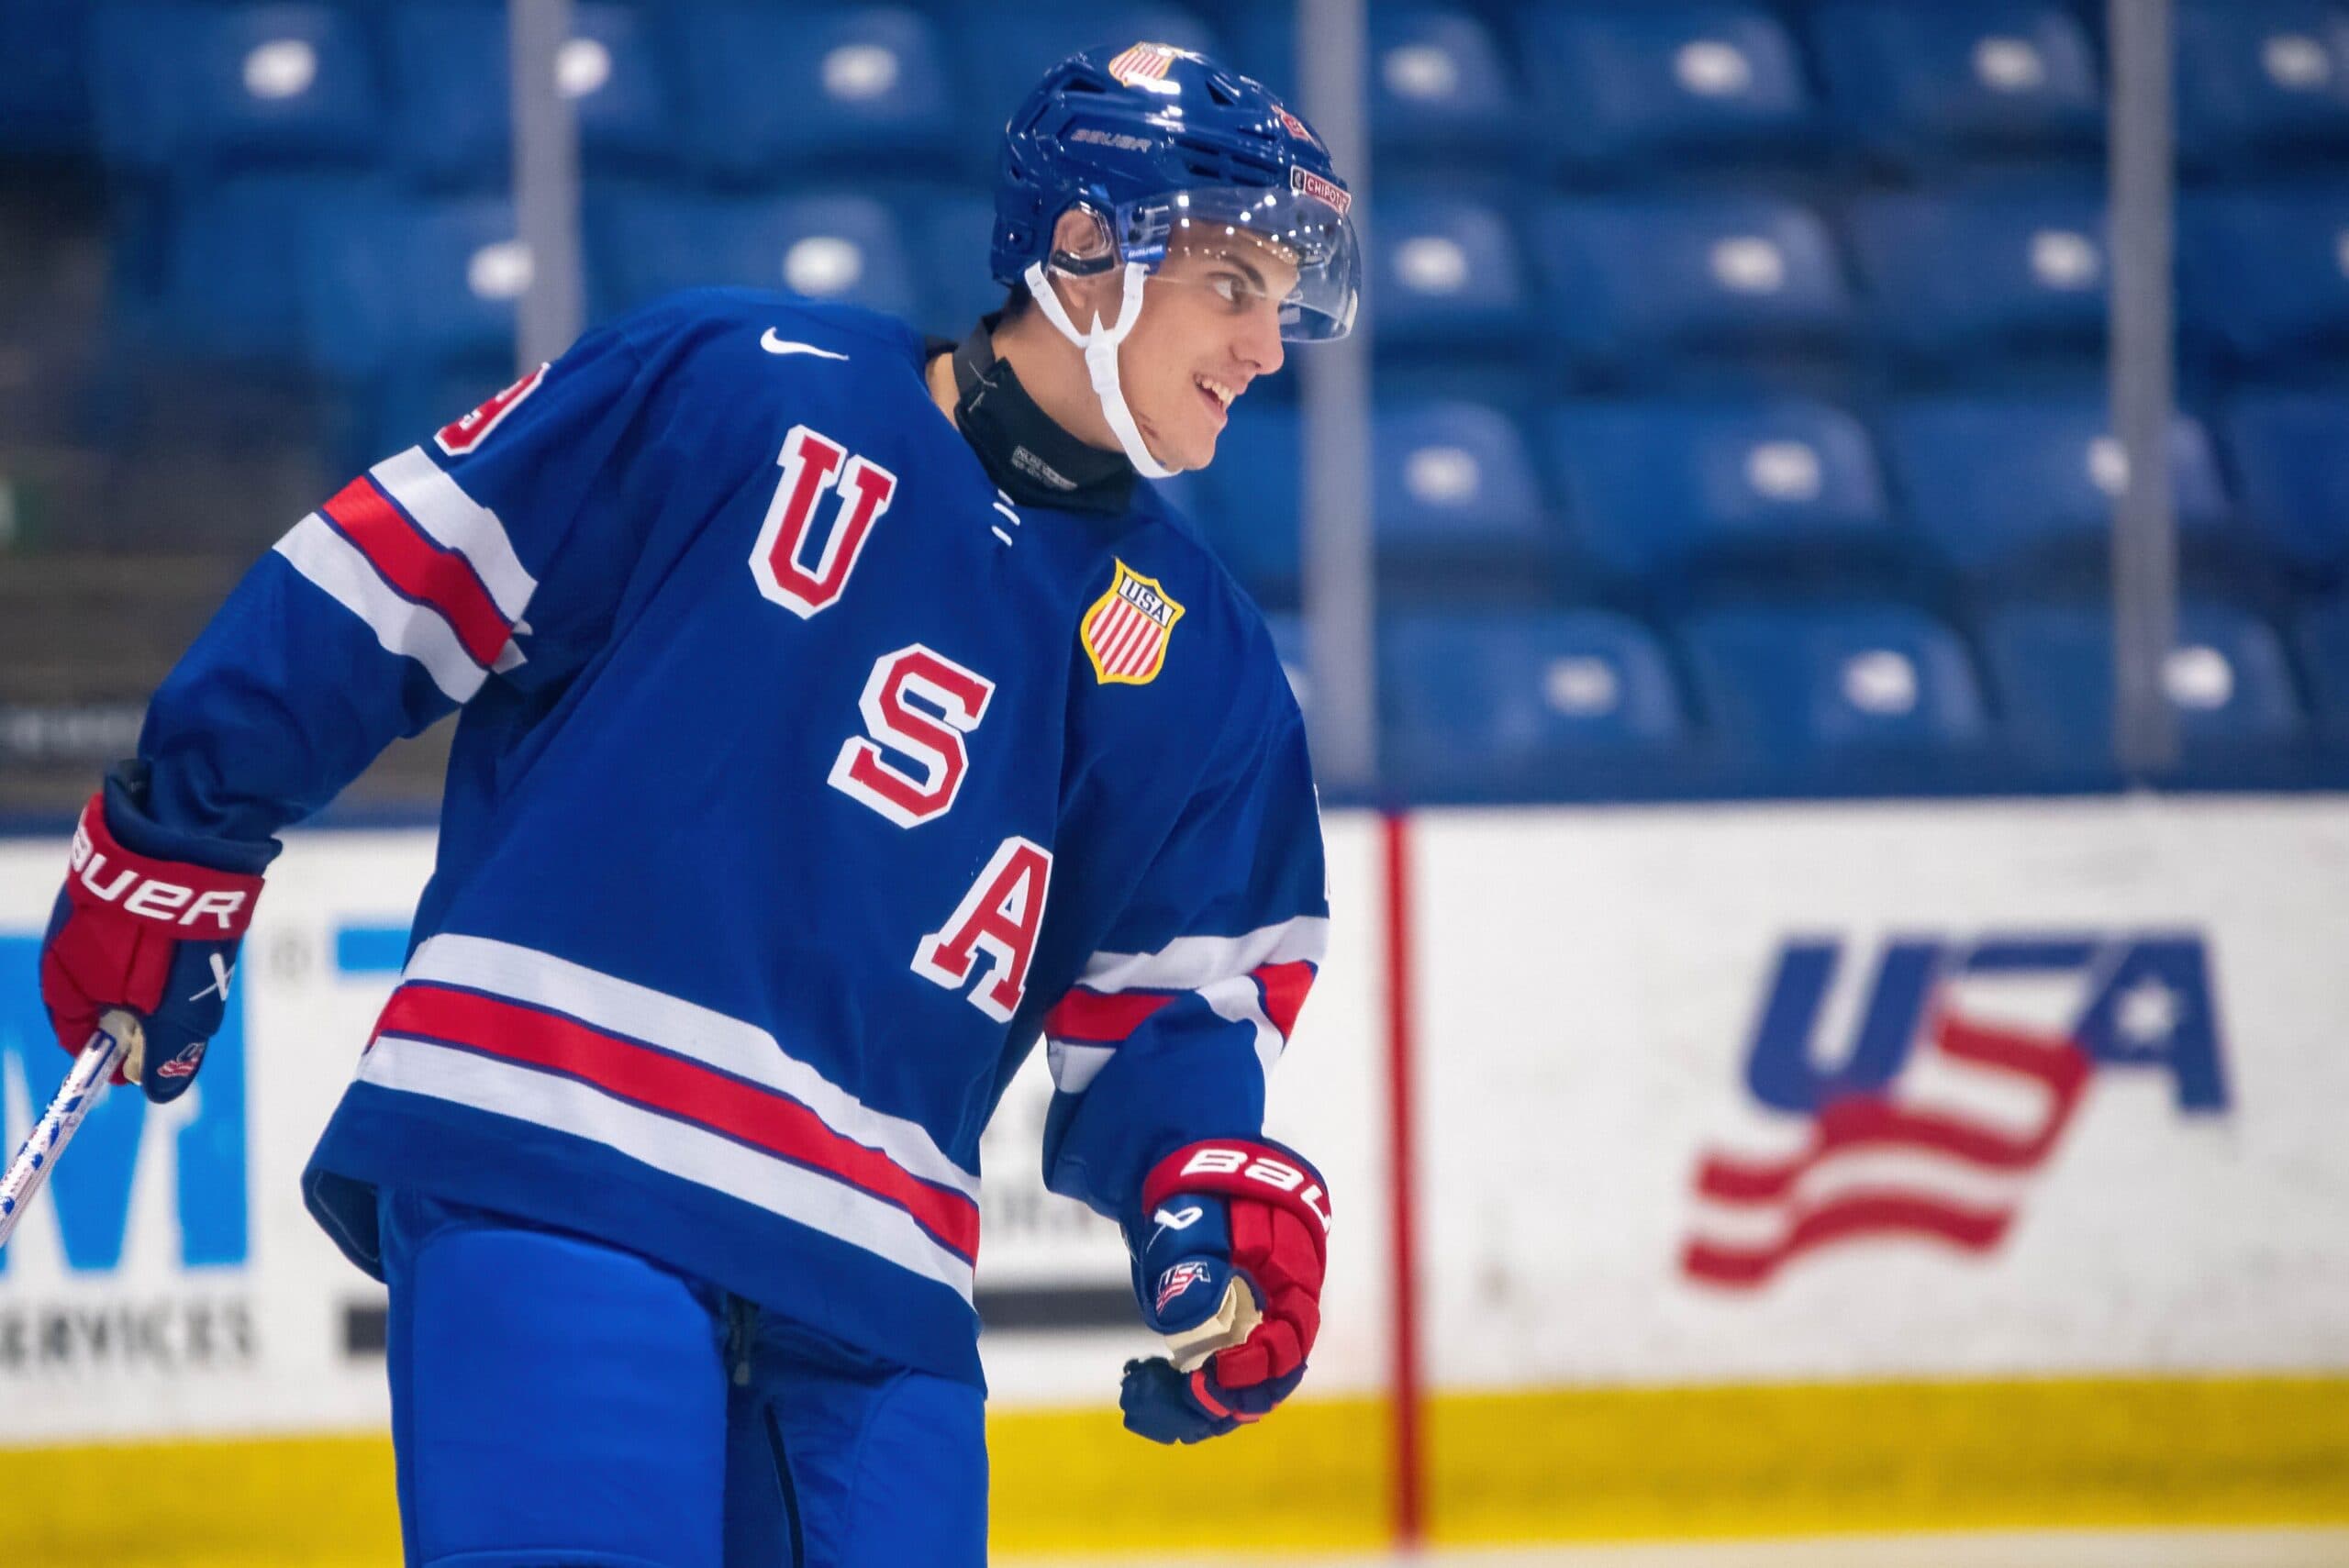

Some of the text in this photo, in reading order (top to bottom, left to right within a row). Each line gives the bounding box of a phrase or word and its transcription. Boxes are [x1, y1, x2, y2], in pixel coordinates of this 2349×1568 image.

[1126, 581, 1165, 622] USA
[72, 807, 247, 929] AUER
[1696, 930, 2237, 1178] USA
[1180, 1149, 1331, 1234] BAU
[1157, 1261, 1211, 1307] USA
